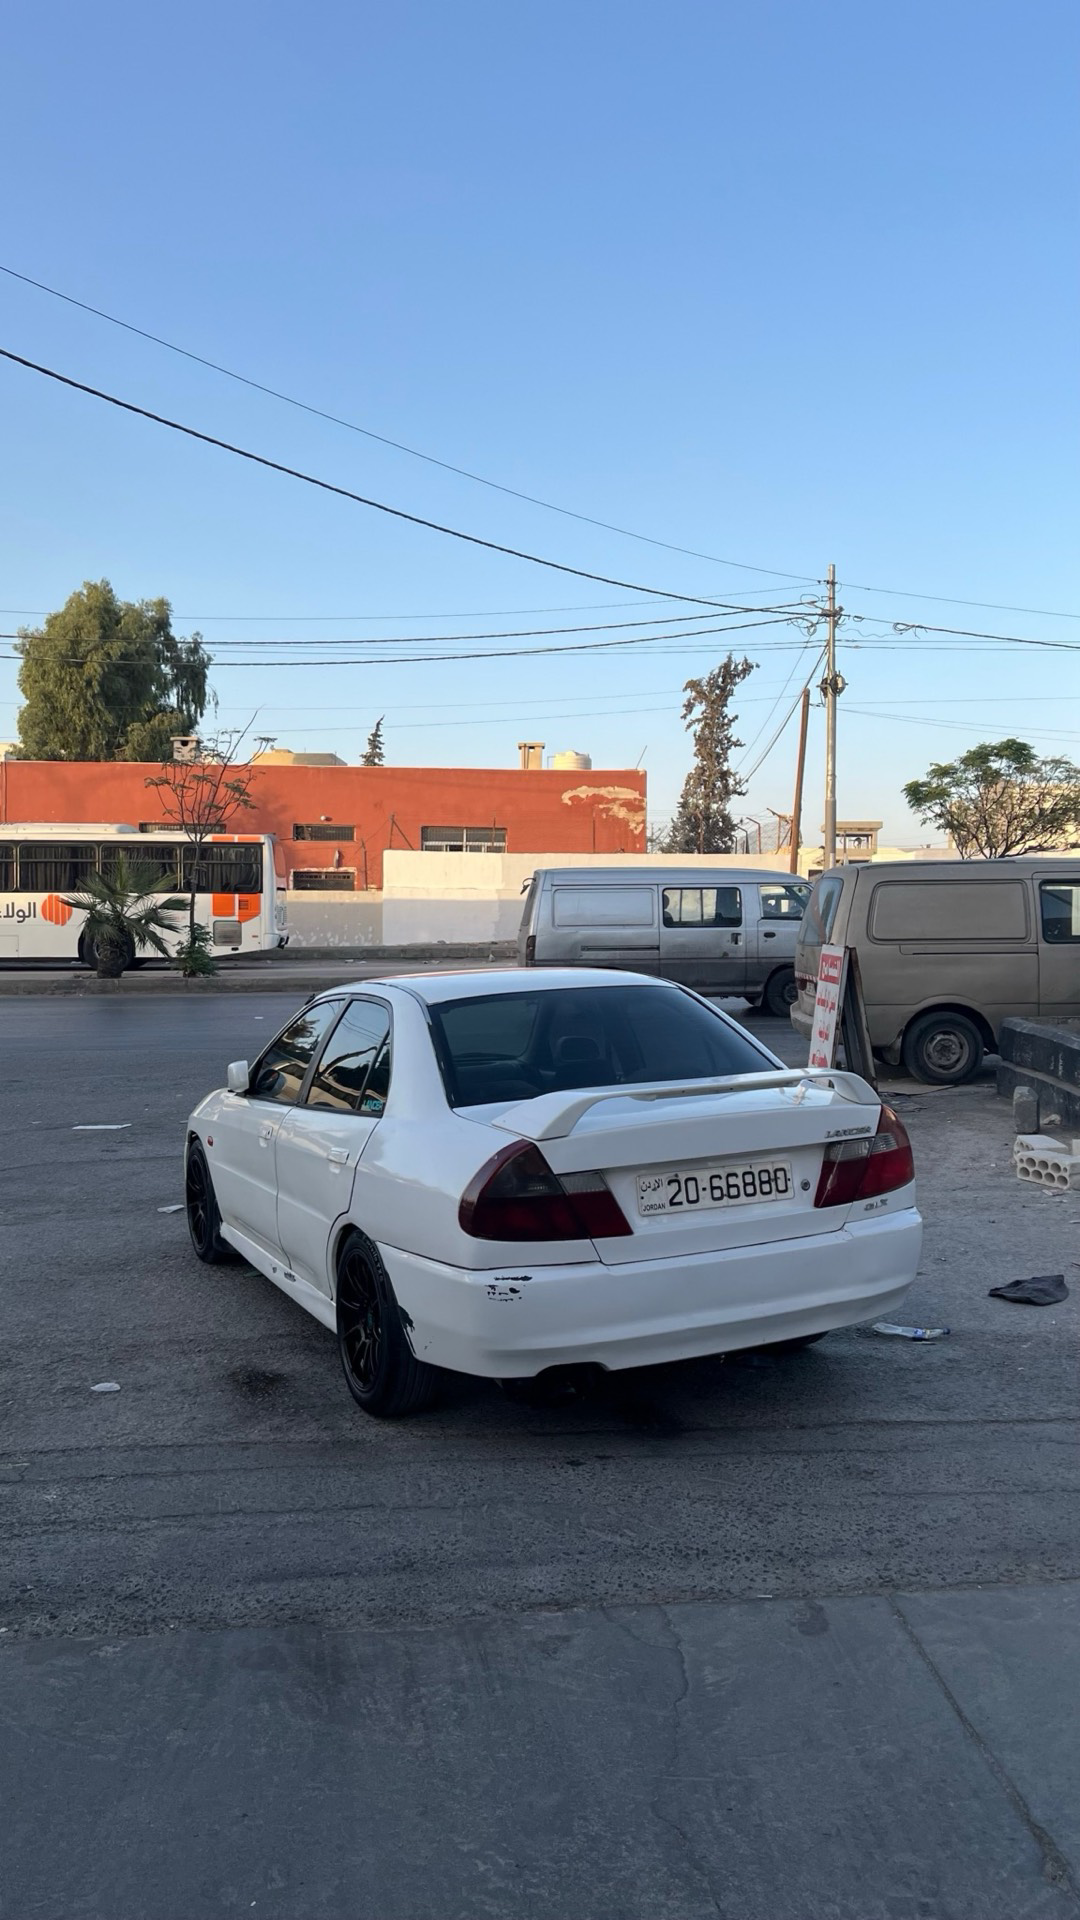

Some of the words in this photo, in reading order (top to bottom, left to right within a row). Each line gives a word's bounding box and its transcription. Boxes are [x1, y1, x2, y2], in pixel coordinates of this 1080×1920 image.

[0, 902, 36, 923] الولا
[667, 1167, 788, 1207] 20-66880
[643, 1202, 666, 1212] JORDAN
